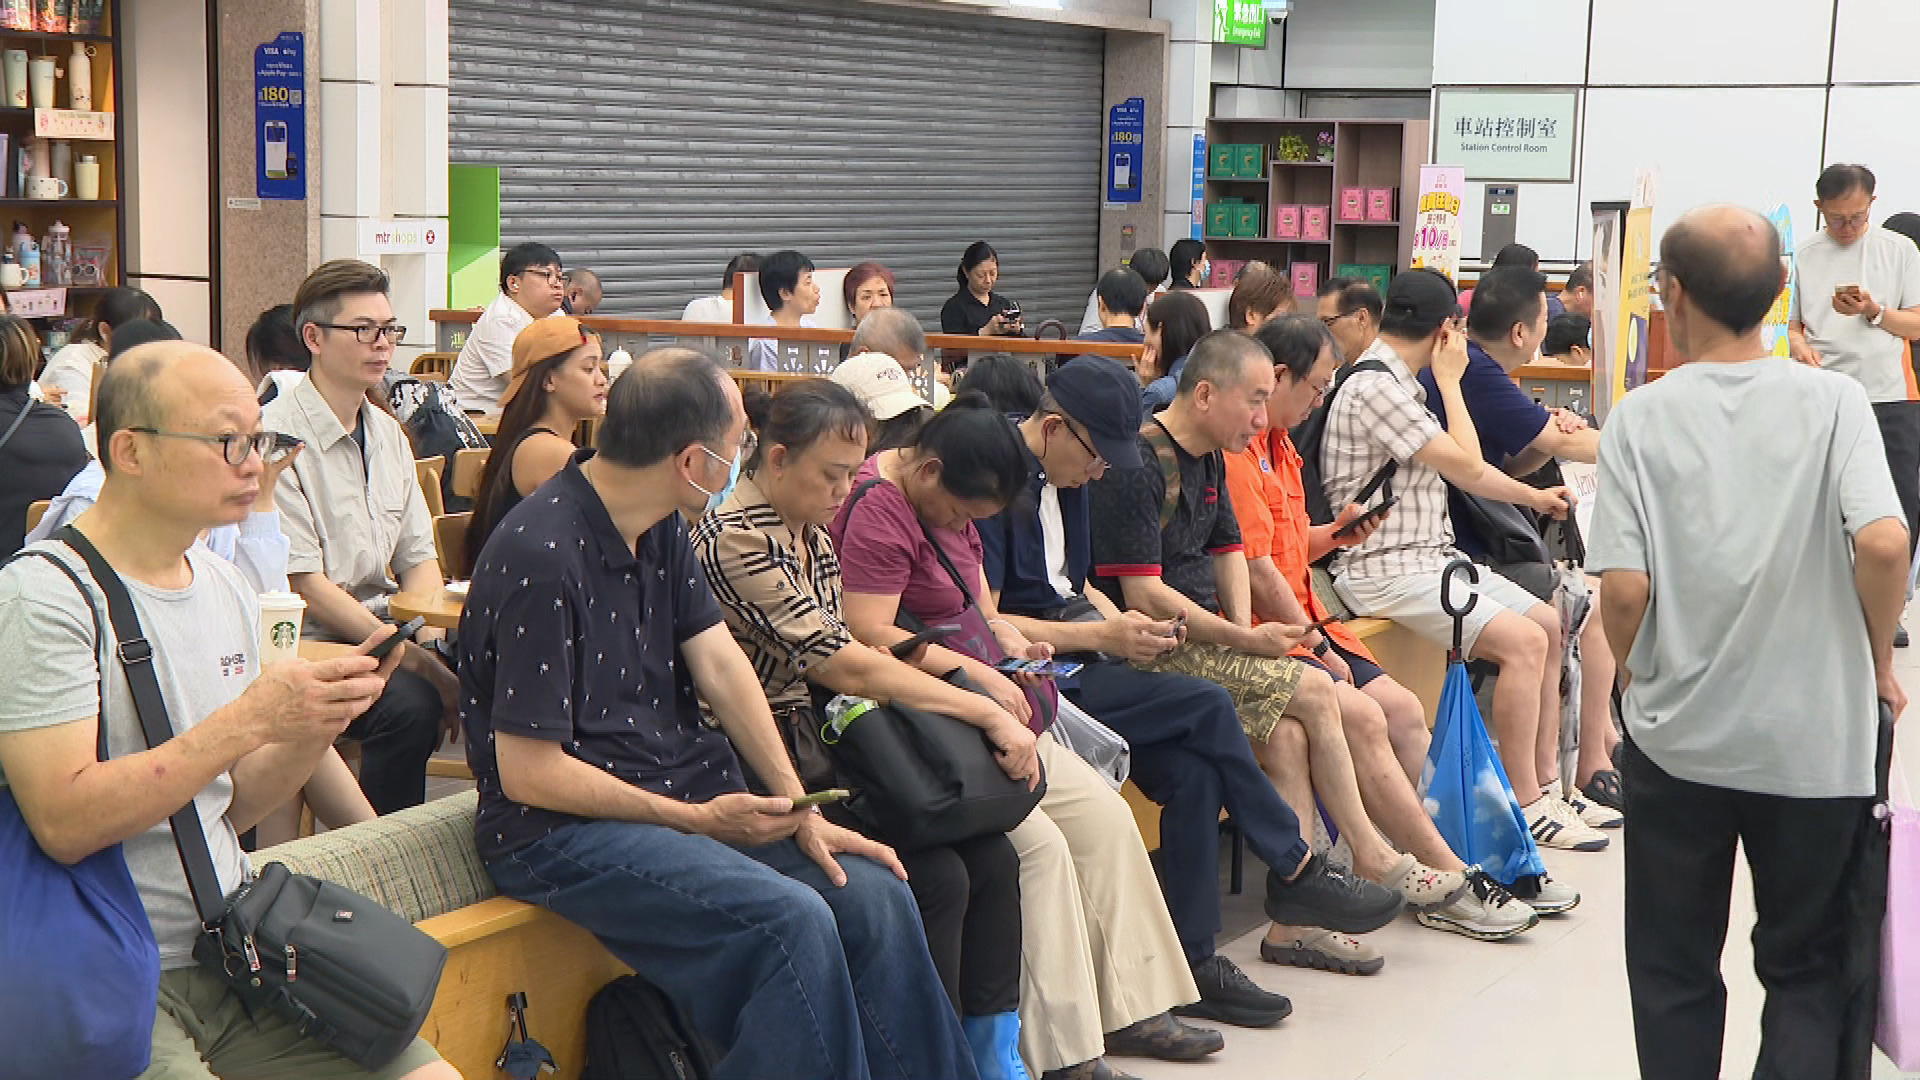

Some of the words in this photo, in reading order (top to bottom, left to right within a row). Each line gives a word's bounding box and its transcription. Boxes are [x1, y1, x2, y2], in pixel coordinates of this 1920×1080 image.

[262, 87, 289, 101] 180
[1453, 116, 1557, 138] 車站控制室
[1115, 132, 1132, 140] 180
[1460, 143, 1490, 151] Station
[1491, 143, 1522, 152] Control
[1523, 144, 1548, 152] Room
[375, 231, 391, 244] mtr
